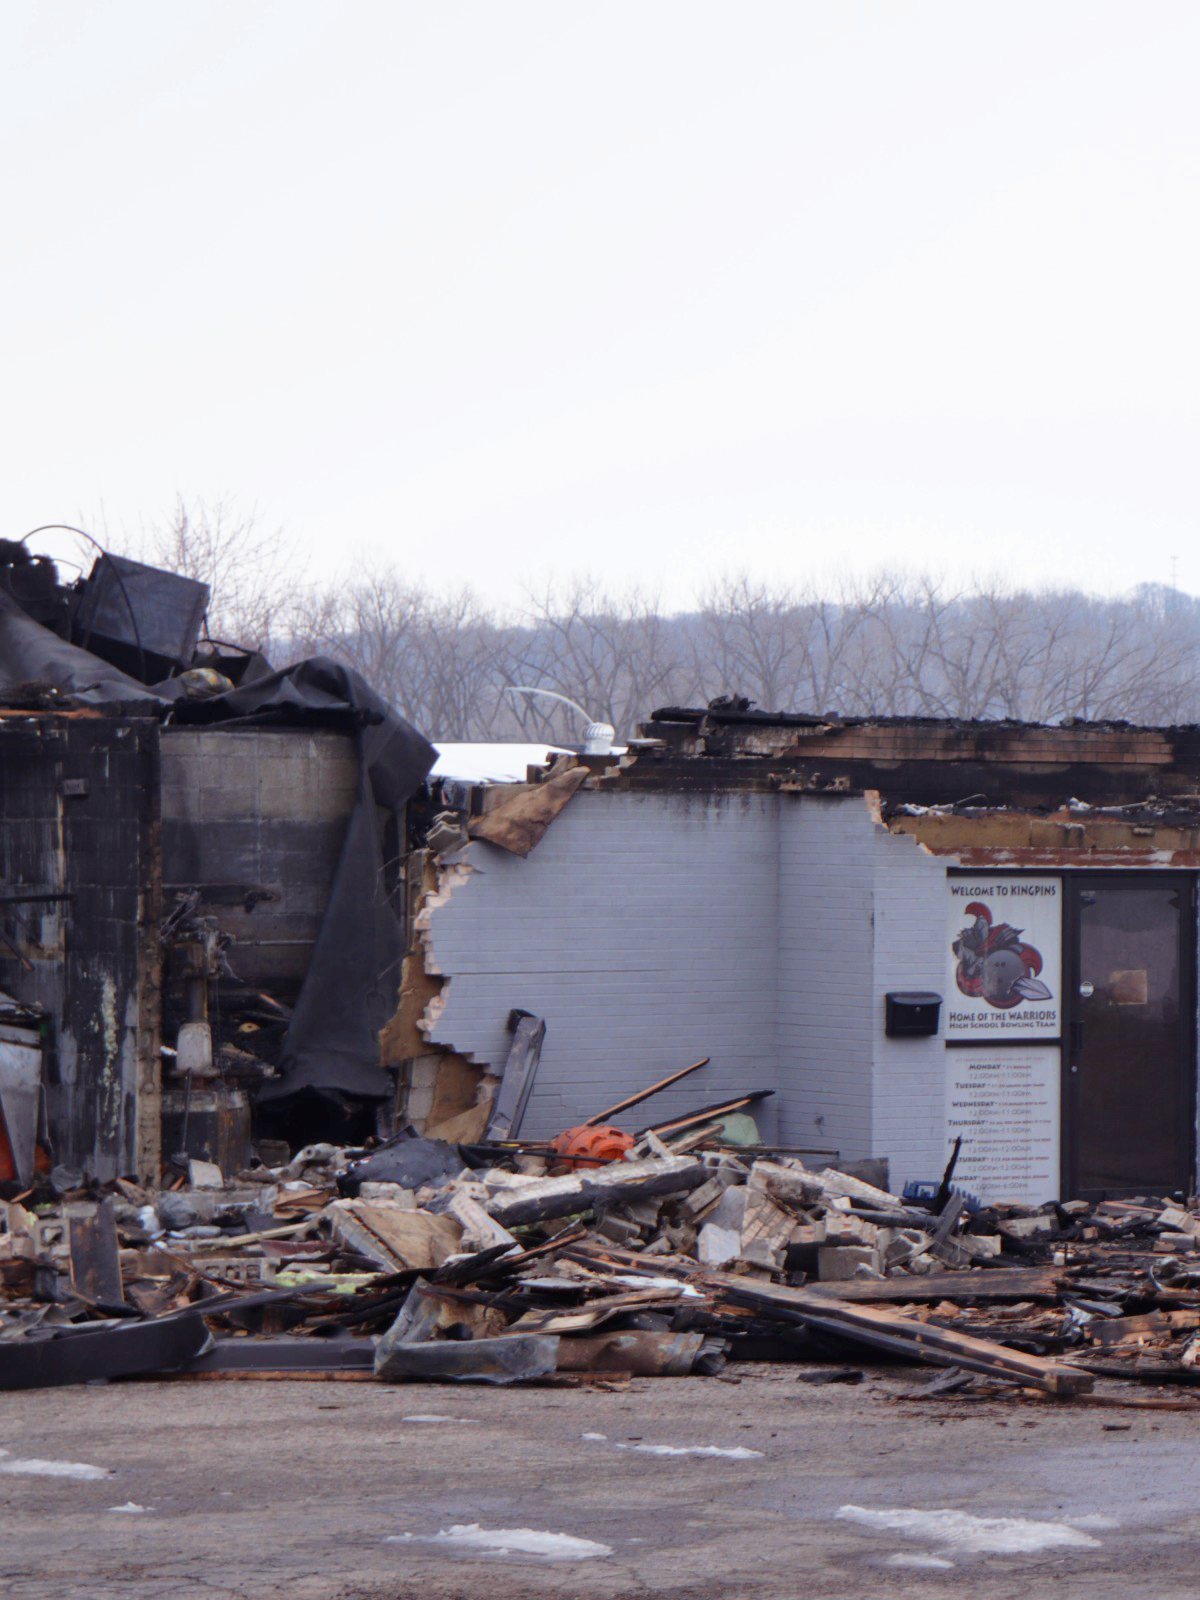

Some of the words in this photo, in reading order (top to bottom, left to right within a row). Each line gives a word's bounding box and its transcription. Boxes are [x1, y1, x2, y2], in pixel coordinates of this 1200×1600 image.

[951, 885, 994, 896] WELCOME
[996, 885, 1009, 896] TO
[1010, 885, 1056, 896] KINGPINS
[949, 1011, 975, 1022] HOME
[977, 1012, 988, 1021] OF
[990, 1012, 1007, 1021] THE
[1008, 1011, 1056, 1021] WARRIORS
